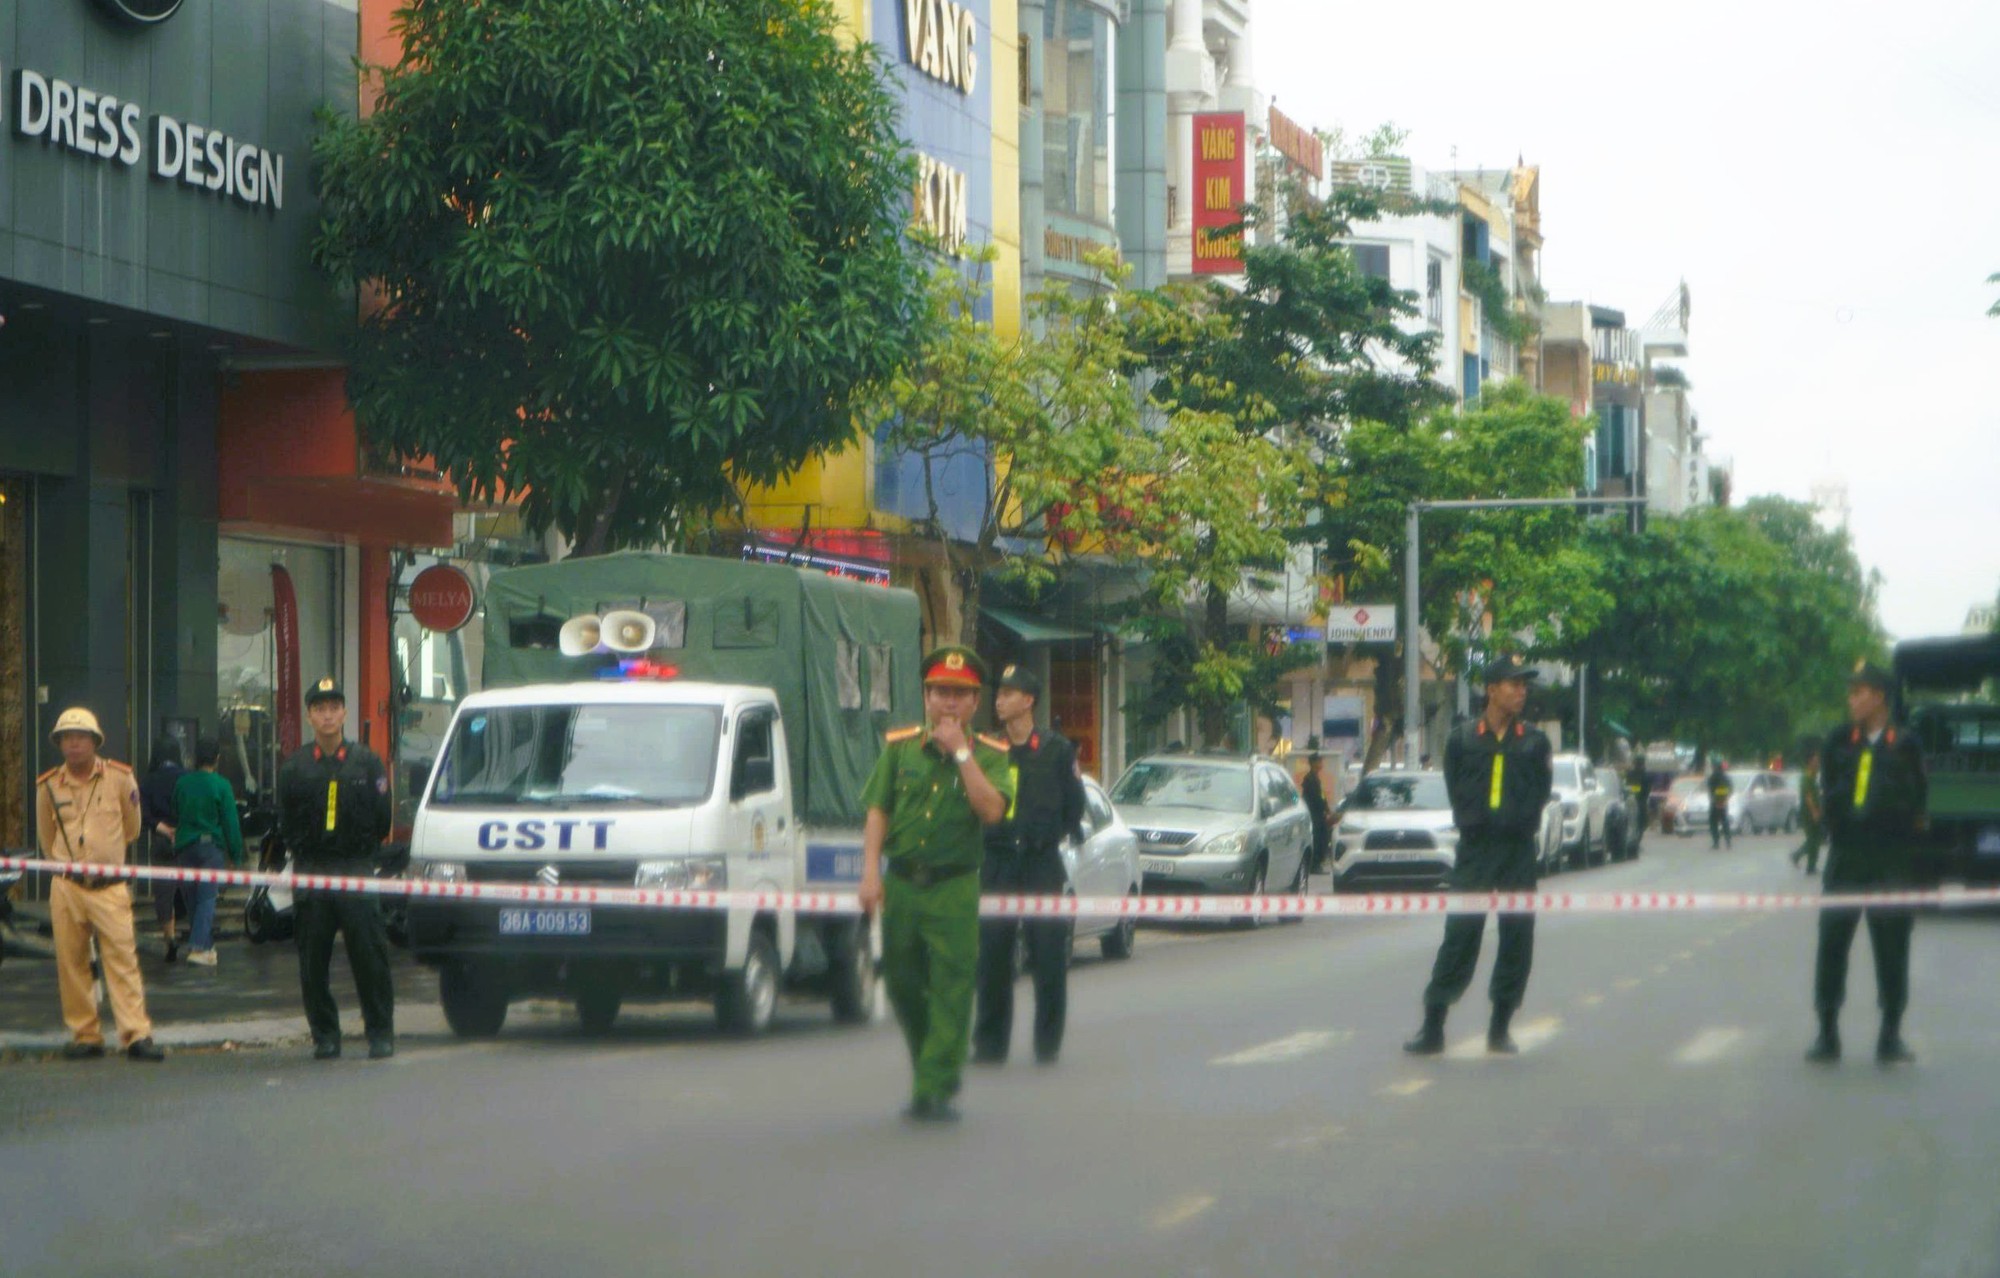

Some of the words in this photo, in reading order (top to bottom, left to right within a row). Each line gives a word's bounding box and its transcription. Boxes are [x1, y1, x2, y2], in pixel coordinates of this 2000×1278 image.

[20, 69, 141, 166] DRESS
[157, 115, 283, 209] DESIGN
[1202, 122, 1235, 160] VÀNG
[1206, 176, 1230, 210] KIM
[414, 591, 469, 608] MELYA
[1330, 627, 1357, 639] JOHN
[477, 819, 616, 851] CSTT
